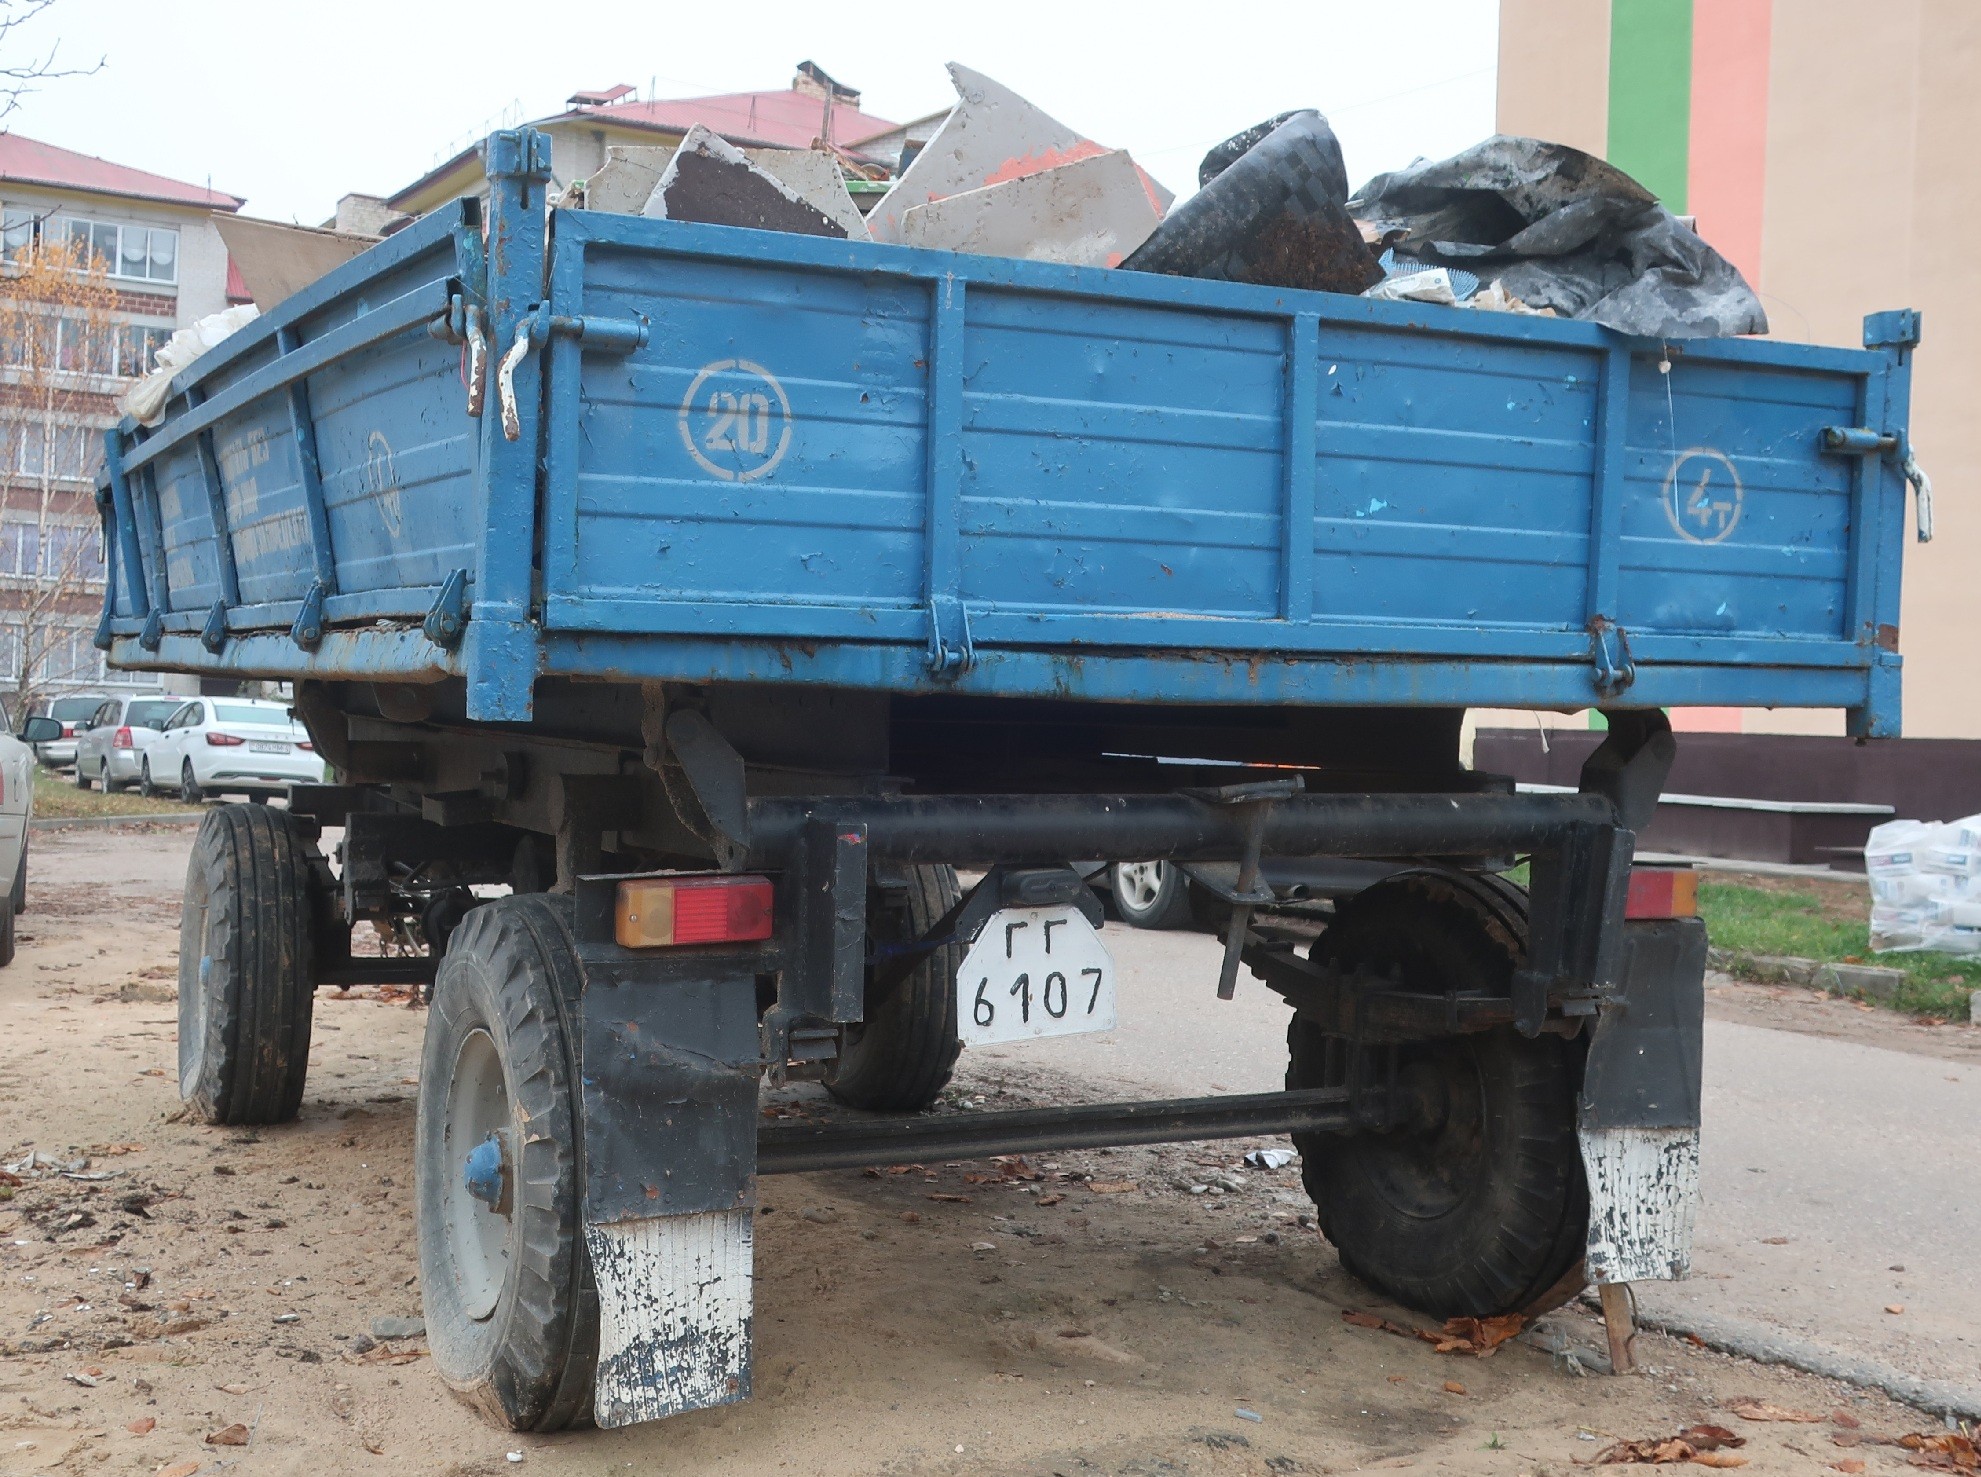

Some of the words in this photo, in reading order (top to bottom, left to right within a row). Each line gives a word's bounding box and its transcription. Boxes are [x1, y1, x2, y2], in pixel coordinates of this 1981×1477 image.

[705, 391, 768, 454] 20
[1005, 918, 1068, 959] ГГ
[973, 967, 1103, 1027] 6107
